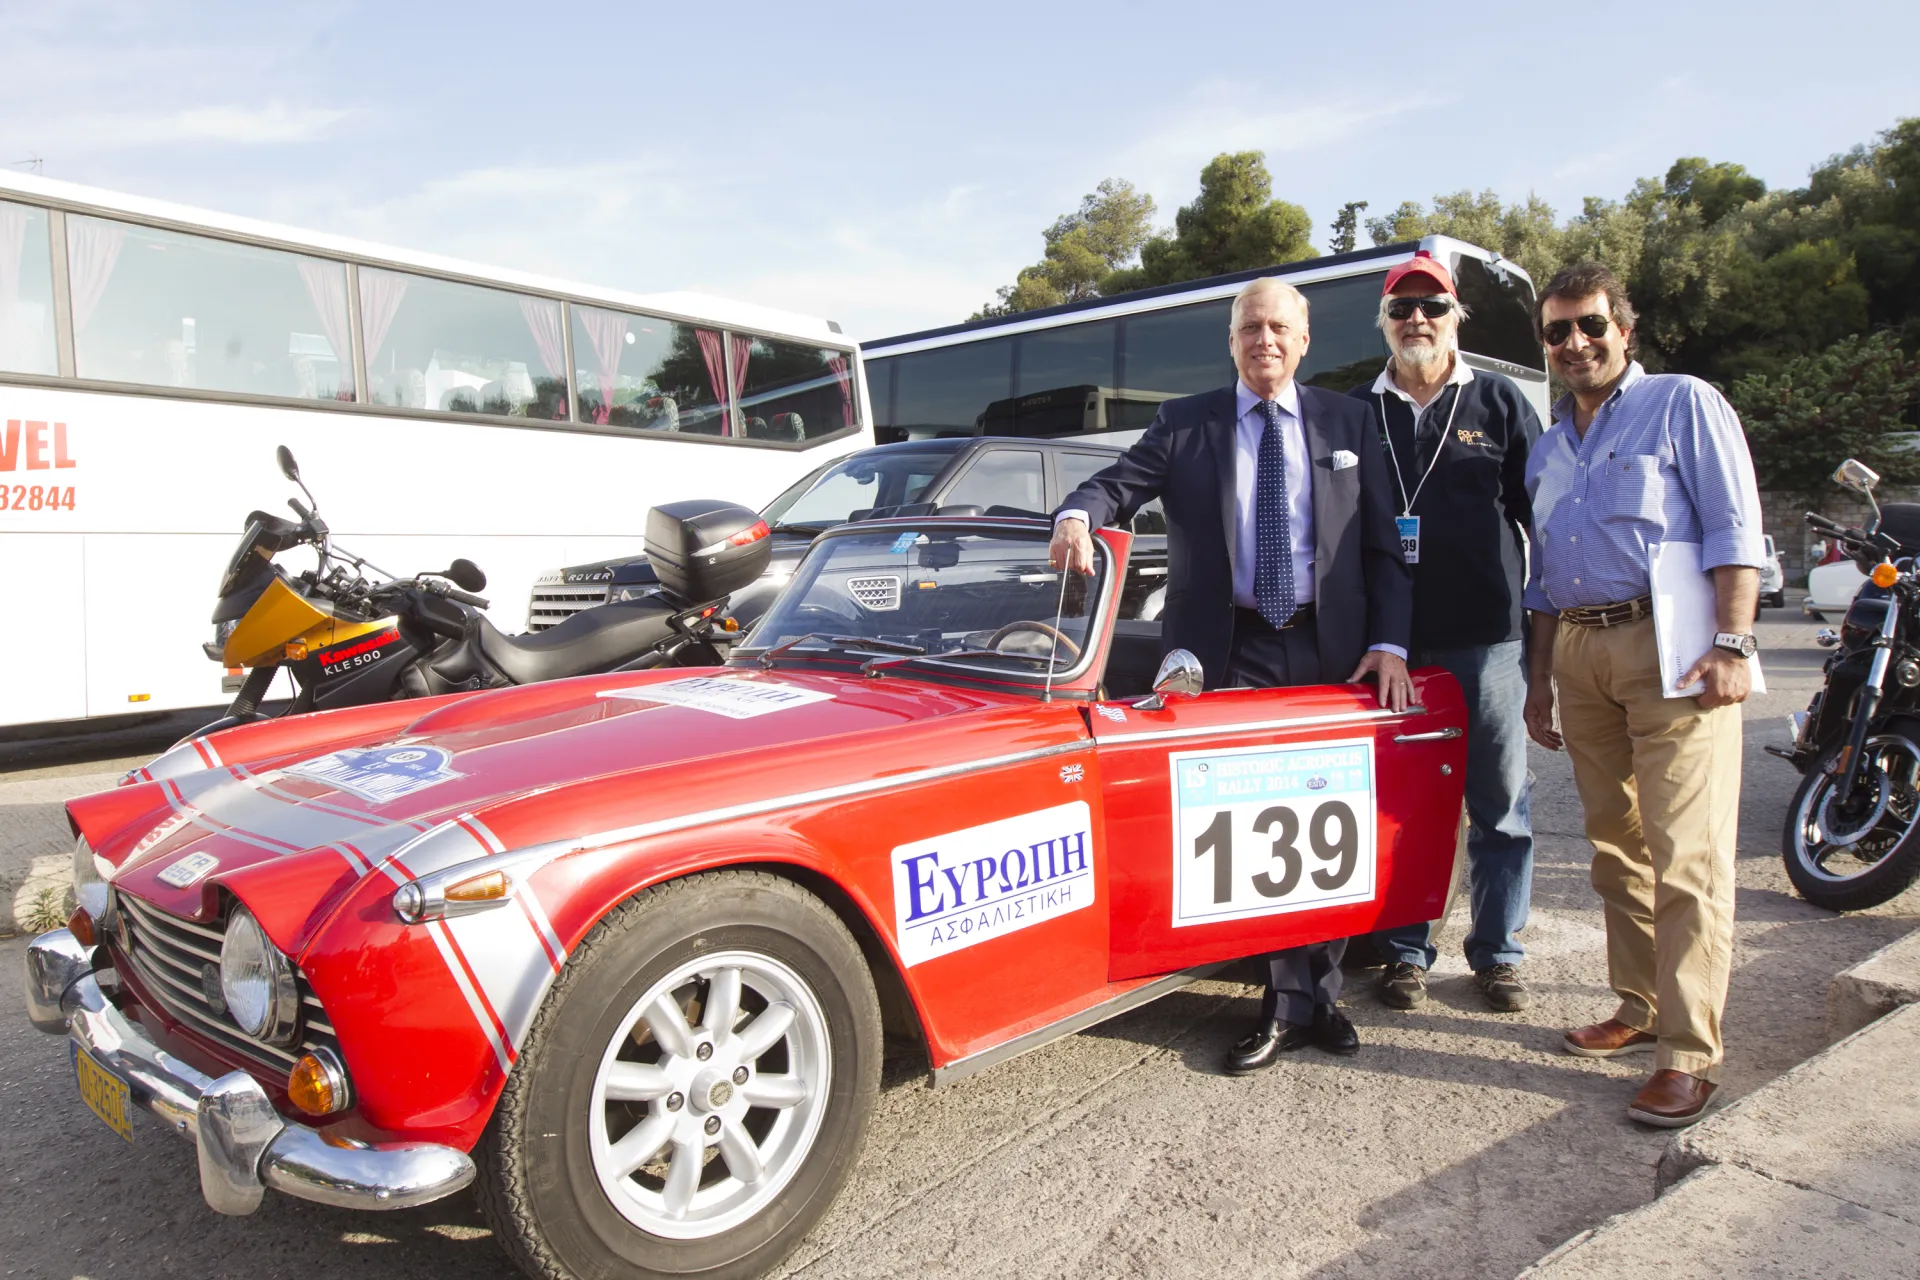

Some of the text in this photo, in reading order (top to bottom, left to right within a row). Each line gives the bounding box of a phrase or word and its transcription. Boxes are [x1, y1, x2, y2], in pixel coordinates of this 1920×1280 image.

[1457, 429, 1483, 438] DOLCE
[568, 572, 611, 581] ROVER
[318, 627, 400, 666] Kawasaki
[324, 650, 381, 676] KLE 500
[1217, 752, 1363, 777] HISTORIC ACROPOLIS
[1217, 775, 1299, 796] RALLY 2014
[186, 854, 210, 868] TR
[1195, 800, 1358, 904] 139
[164, 864, 196, 882] 250
[901, 831, 1088, 923] ΕΥΡΩΠΗ
[930, 885, 1072, 946] ΑΣΦΑΛΙΣΤΙΚΗ
